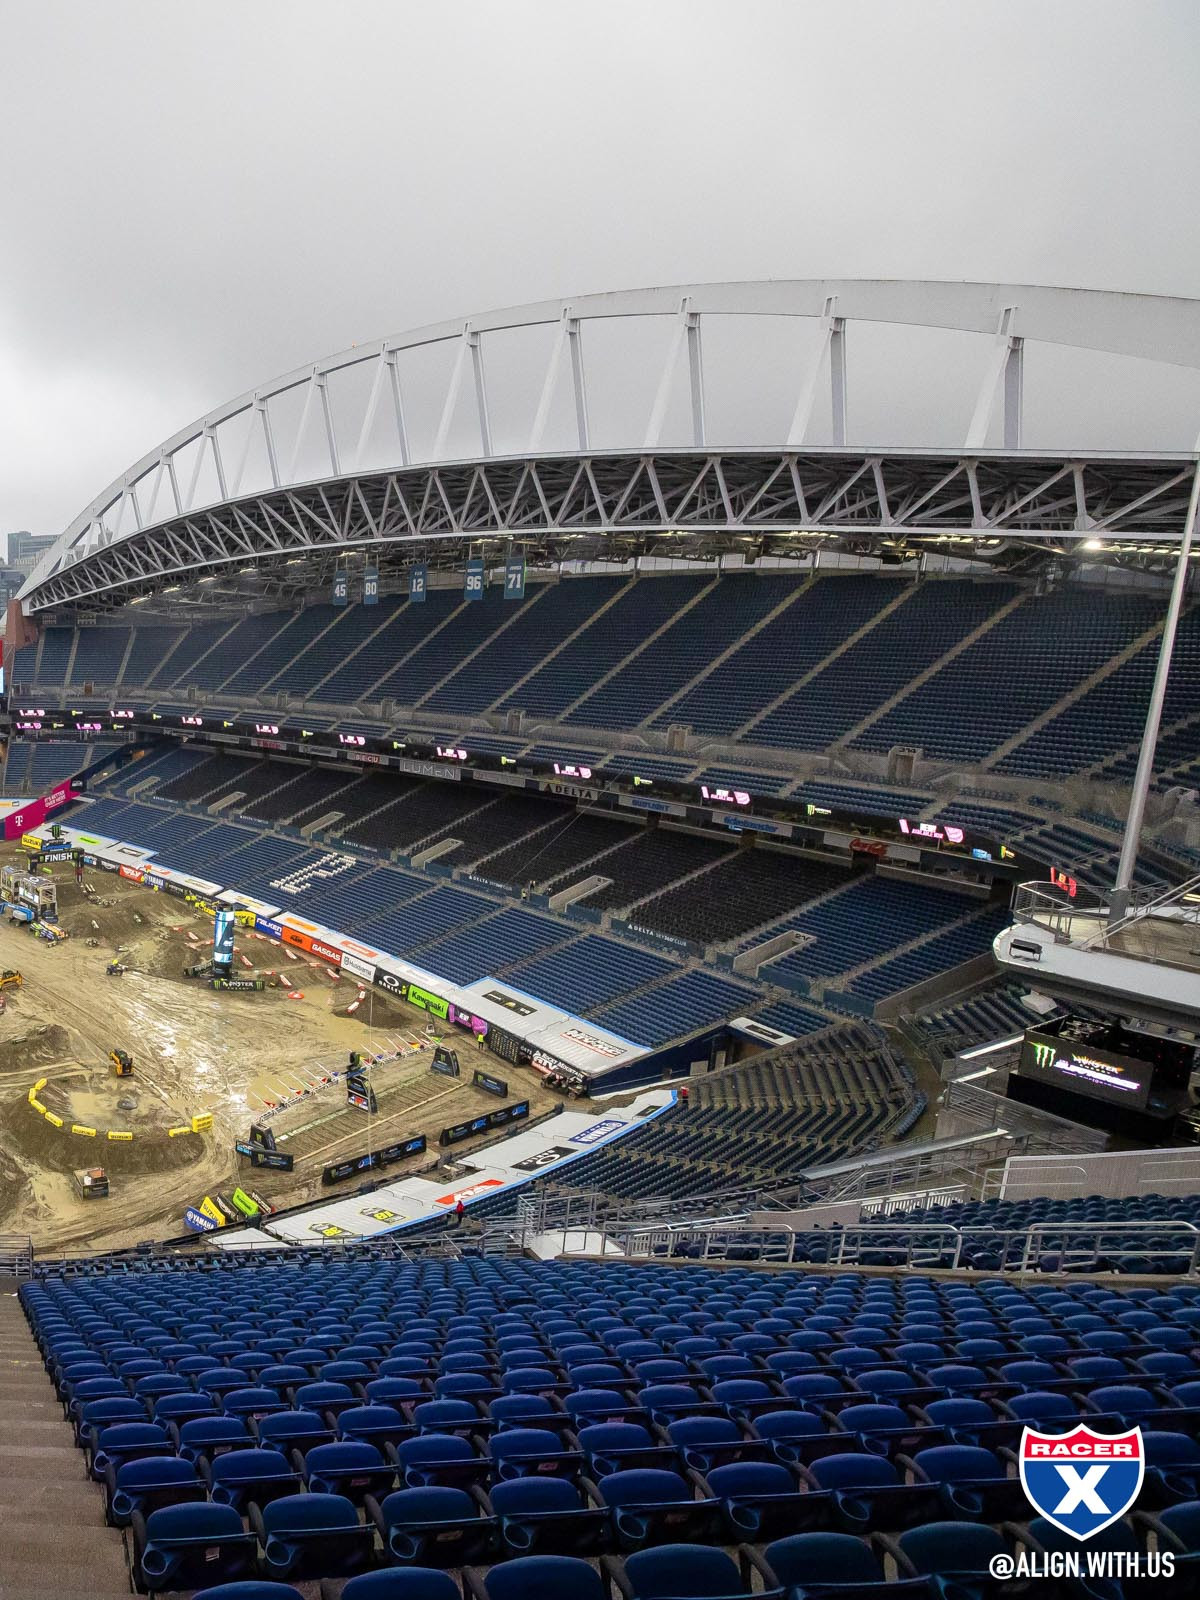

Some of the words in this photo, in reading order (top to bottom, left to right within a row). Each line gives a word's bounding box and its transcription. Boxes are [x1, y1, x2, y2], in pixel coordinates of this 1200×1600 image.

[412, 578, 424, 592] 12
[467, 576, 481, 590] 96
[508, 574, 521, 588] 71
[334, 584, 346, 596] 45
[403, 763, 455, 778] LUMEN
[555, 784, 592, 798] DELTA
[44, 852, 73, 862] FINISH
[256, 918, 282, 932] FALKEN
[312, 944, 342, 961] GASGAS
[349, 960, 372, 976] Husqvarna
[222, 980, 254, 988] MONSTER
[412, 990, 444, 1013] Kawasaki
[192, 1212, 214, 1230] YAMAHA
